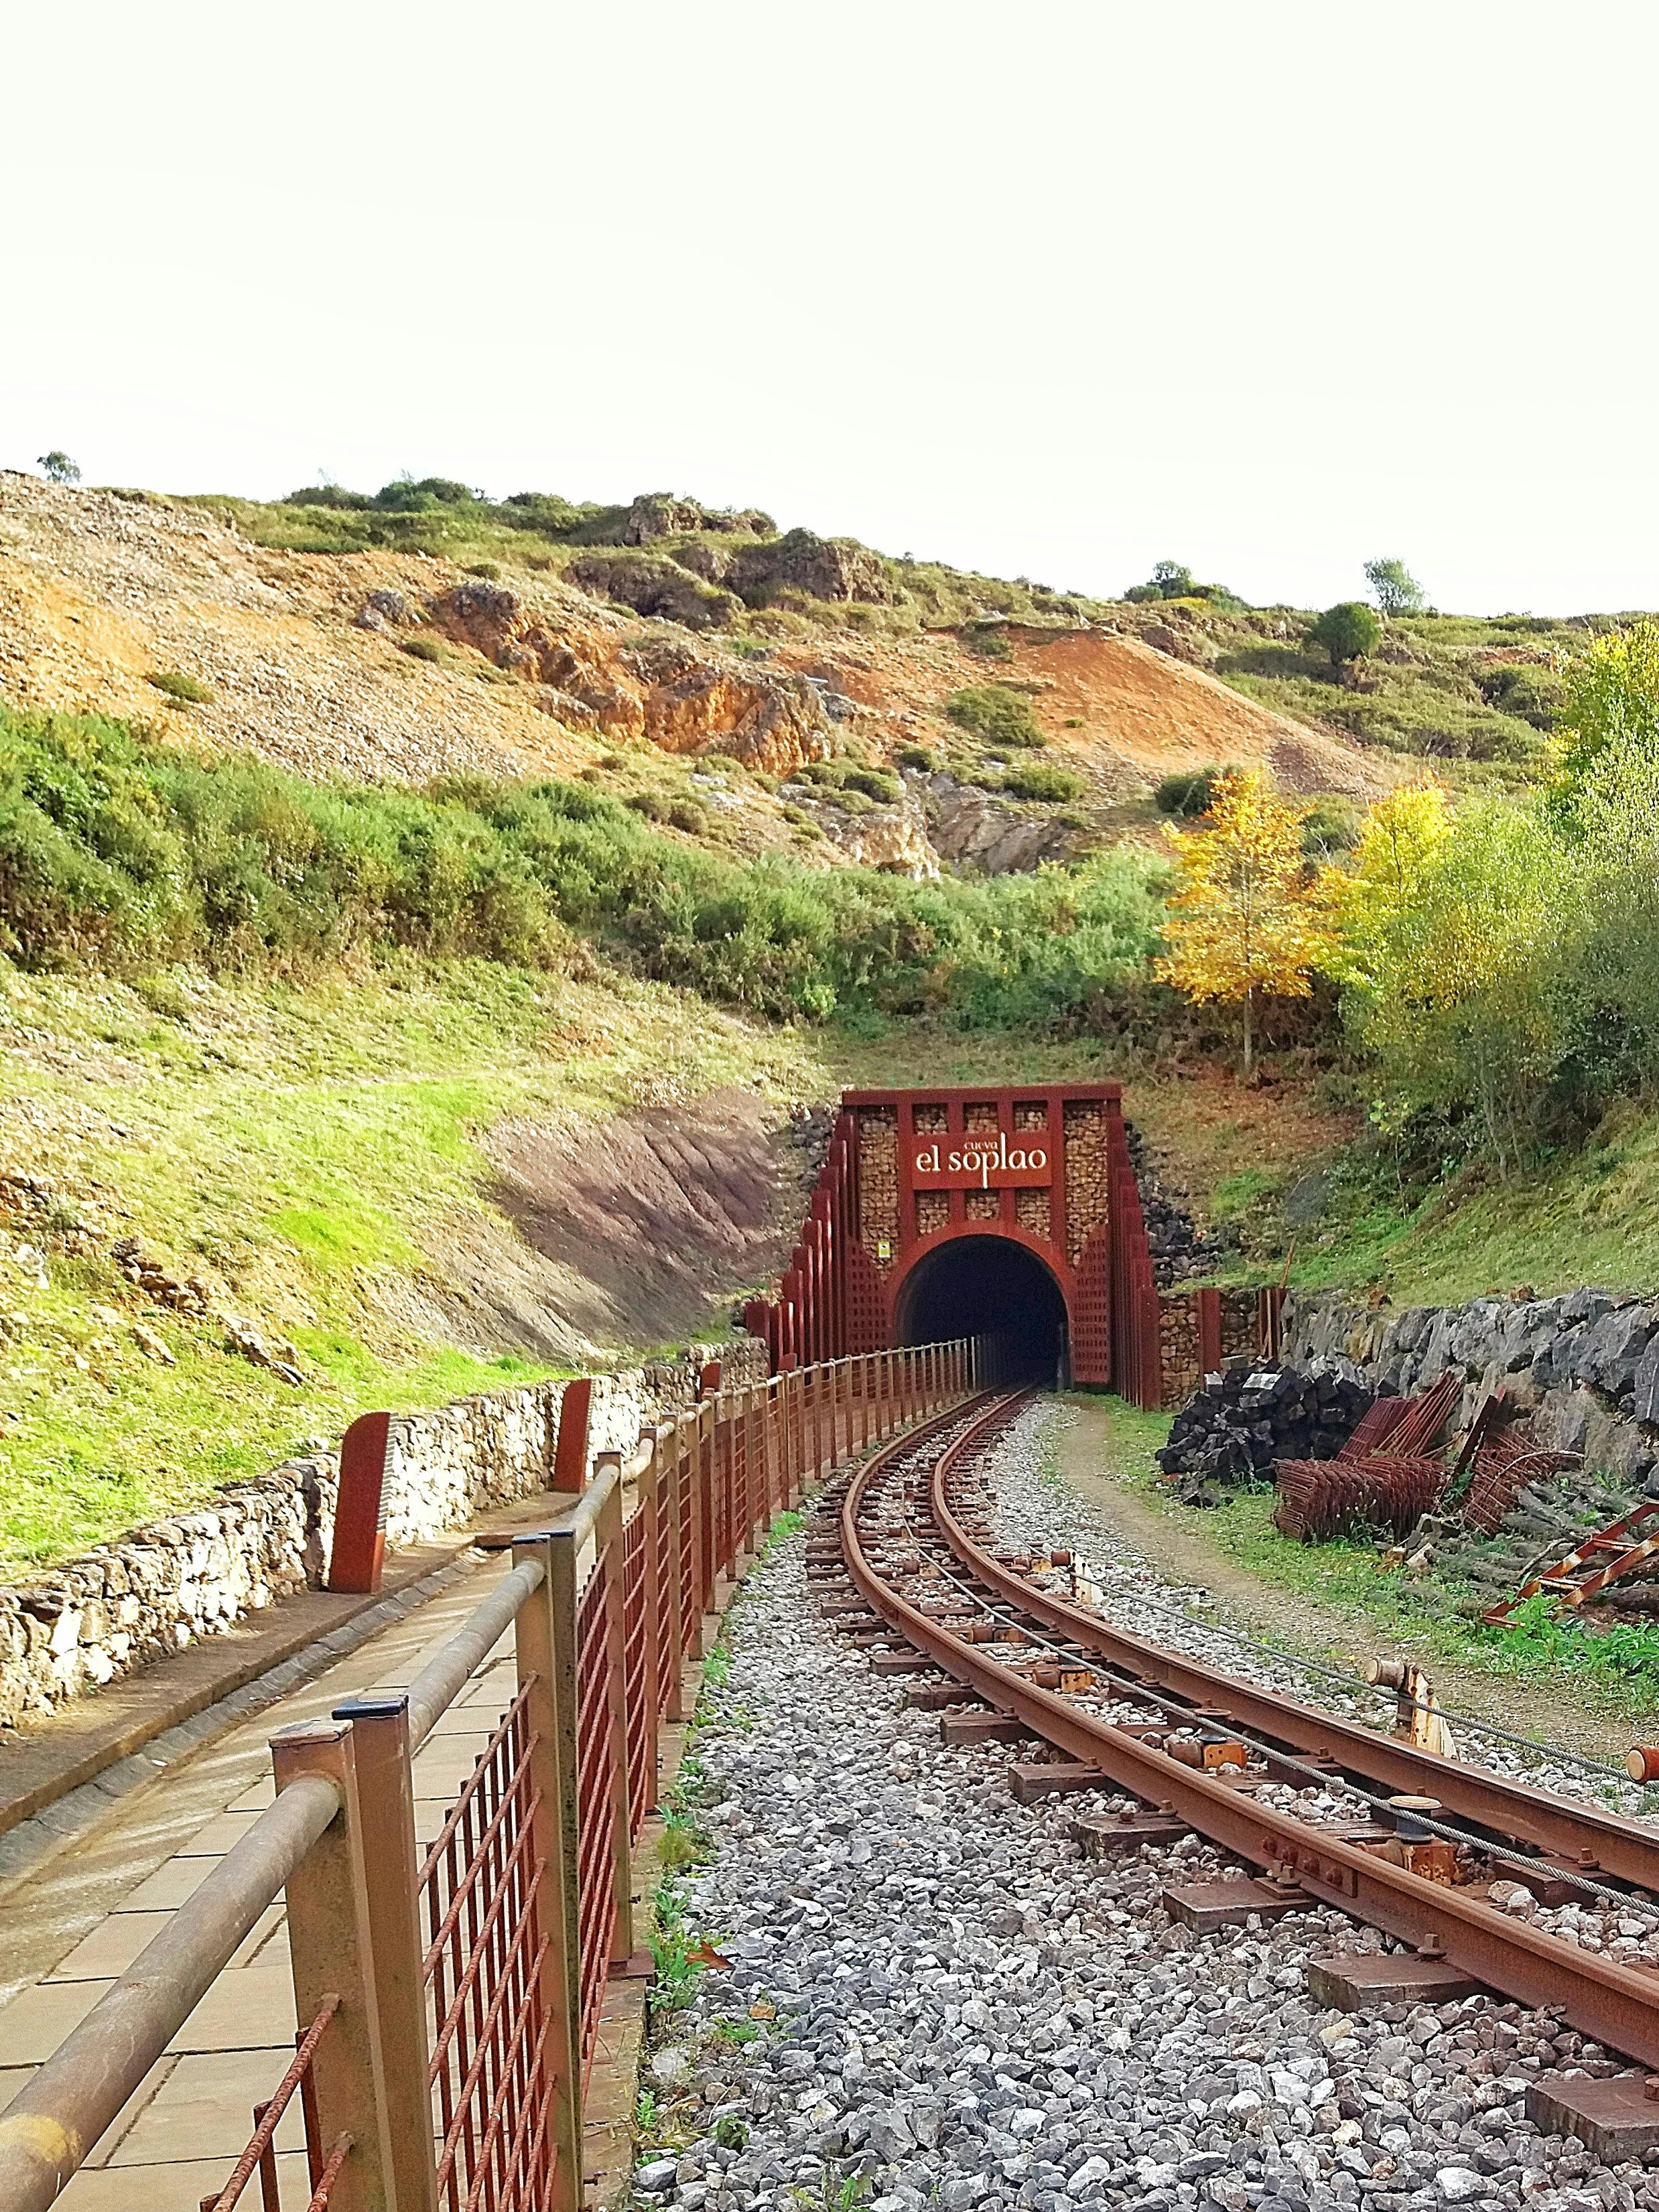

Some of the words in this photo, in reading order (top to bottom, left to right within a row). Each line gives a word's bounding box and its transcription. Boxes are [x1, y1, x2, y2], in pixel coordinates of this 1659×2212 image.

[916, 1145, 941, 1172] el
[948, 1132, 1047, 1189] soplao
[964, 1141, 998, 1150] cueva
